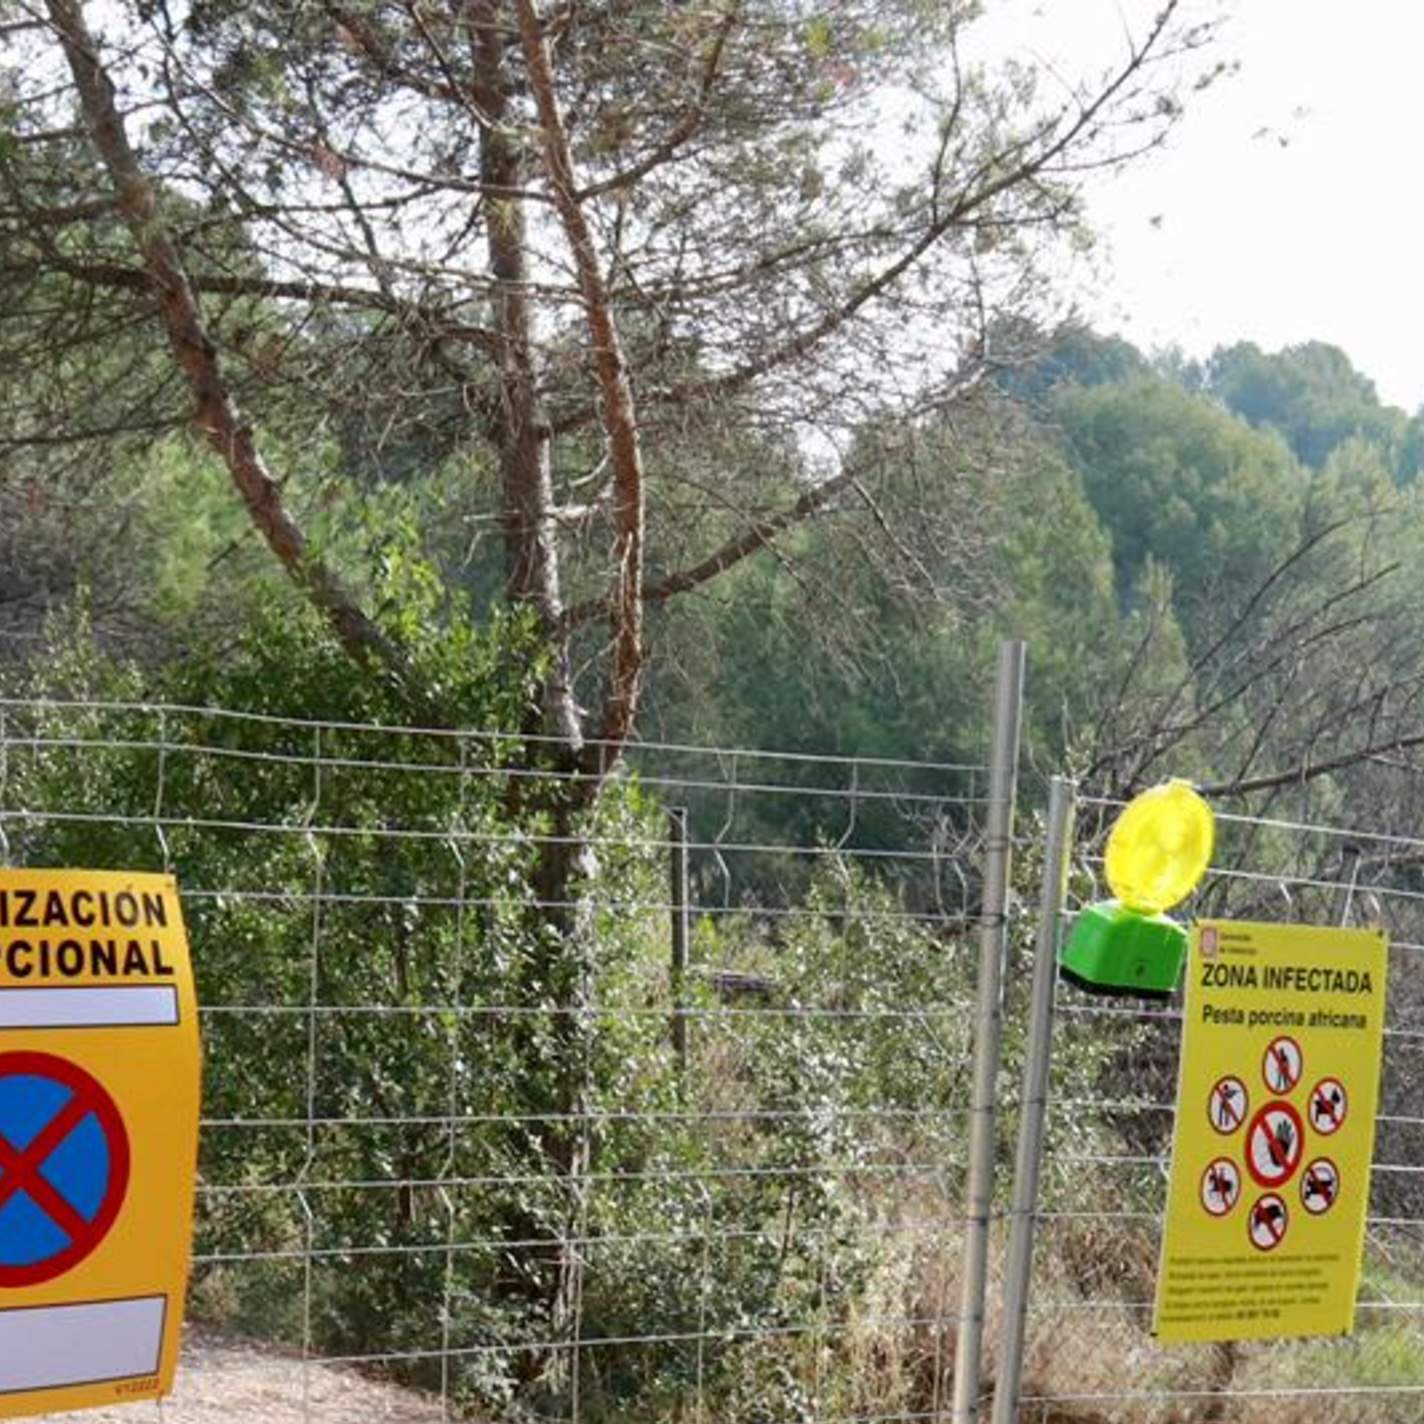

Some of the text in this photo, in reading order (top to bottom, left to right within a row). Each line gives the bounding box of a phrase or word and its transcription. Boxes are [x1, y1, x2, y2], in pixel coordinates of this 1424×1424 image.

[1201, 963, 1373, 995] ZONA INFECTADA
[1202, 1004, 1368, 1029] Pesta porcina africana
